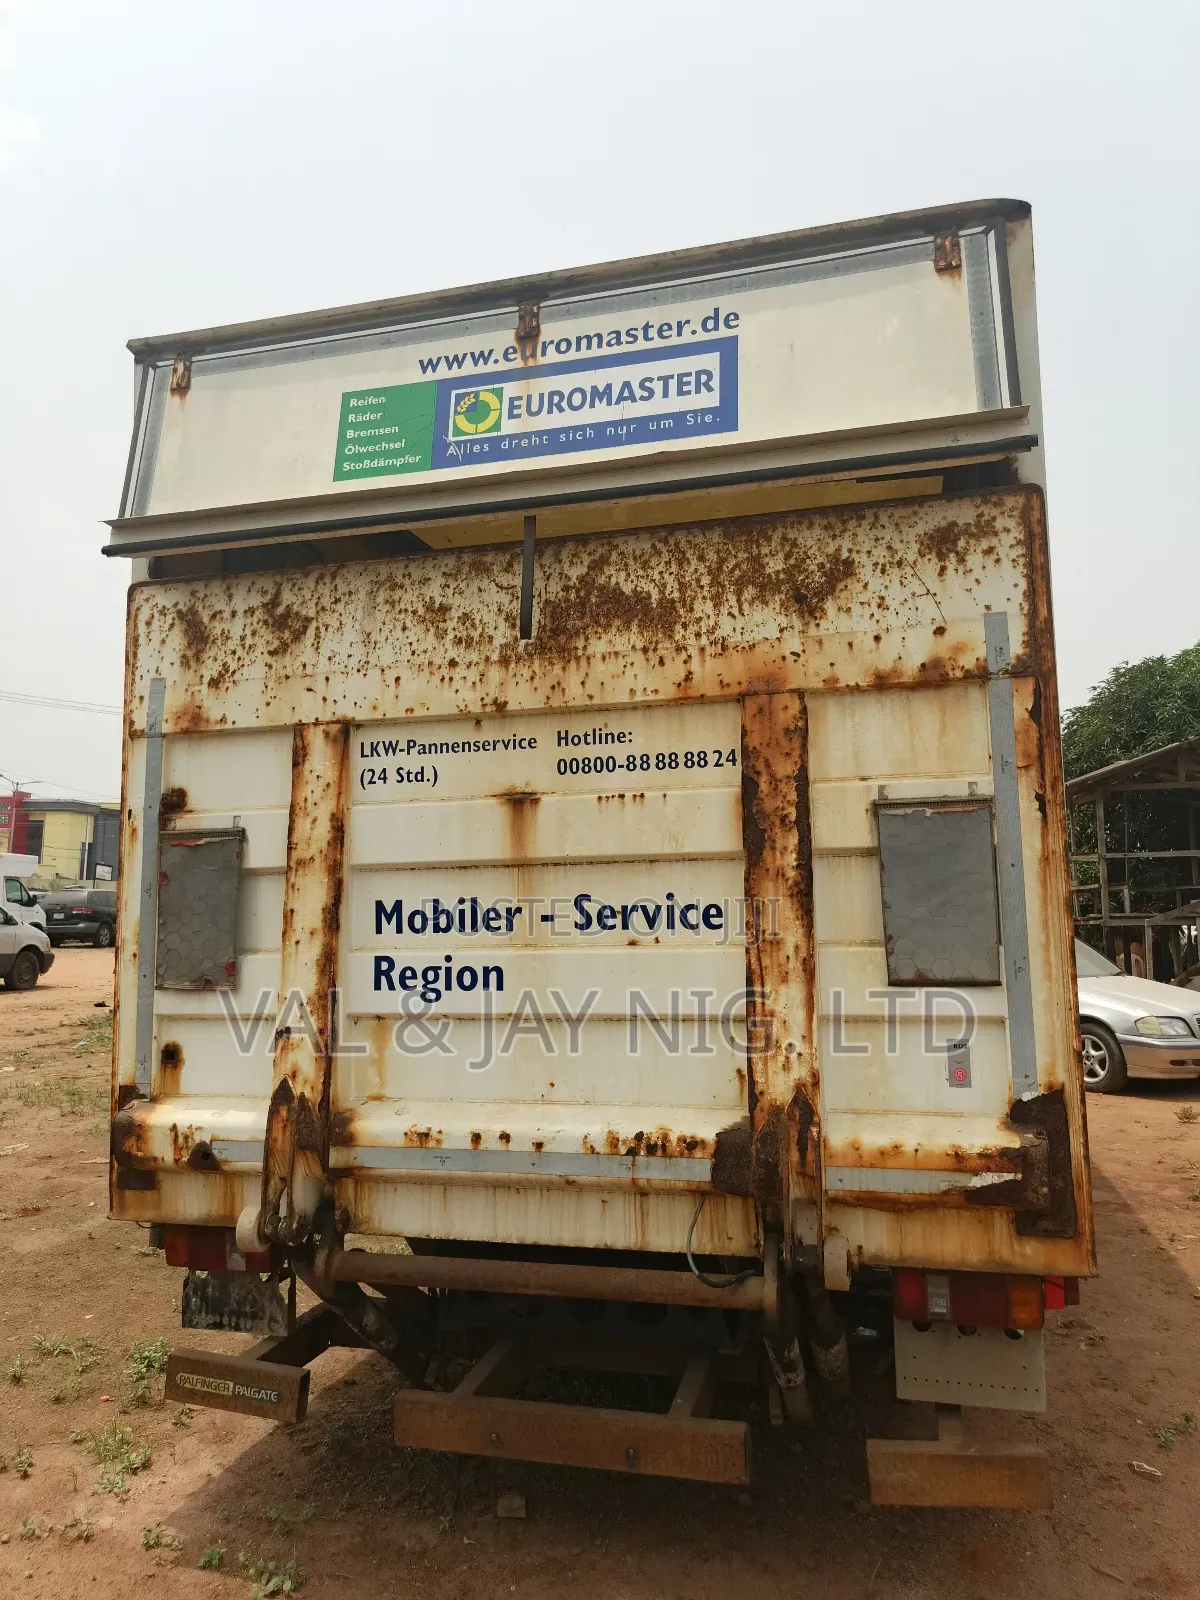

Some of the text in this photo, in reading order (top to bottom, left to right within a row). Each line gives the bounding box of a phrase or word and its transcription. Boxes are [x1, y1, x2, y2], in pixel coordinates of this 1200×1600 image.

[418, 307, 740, 374] www.euromaster.de
[349, 396, 387, 408] Reifen
[507, 368, 715, 420] EUROMASTER
[348, 412, 383, 423] Räder
[346, 426, 399, 439] Bremsen
[446, 413, 721, 457] Alles dreht sich nur um Sie.
[344, 439, 406, 455] Ölwechsel
[342, 455, 422, 471] Stoßdämpfer
[360, 733, 538, 759] LKW-Pannenservice
[556, 728, 633, 747] Hotline:
[360, 765, 439, 790] (24 Std.)
[374, 897, 523, 935] Mobiler
[573, 892, 724, 931] Service
[373, 954, 504, 1003] Region
[179, 1374, 279, 1402] PALFINGER PALGATE
